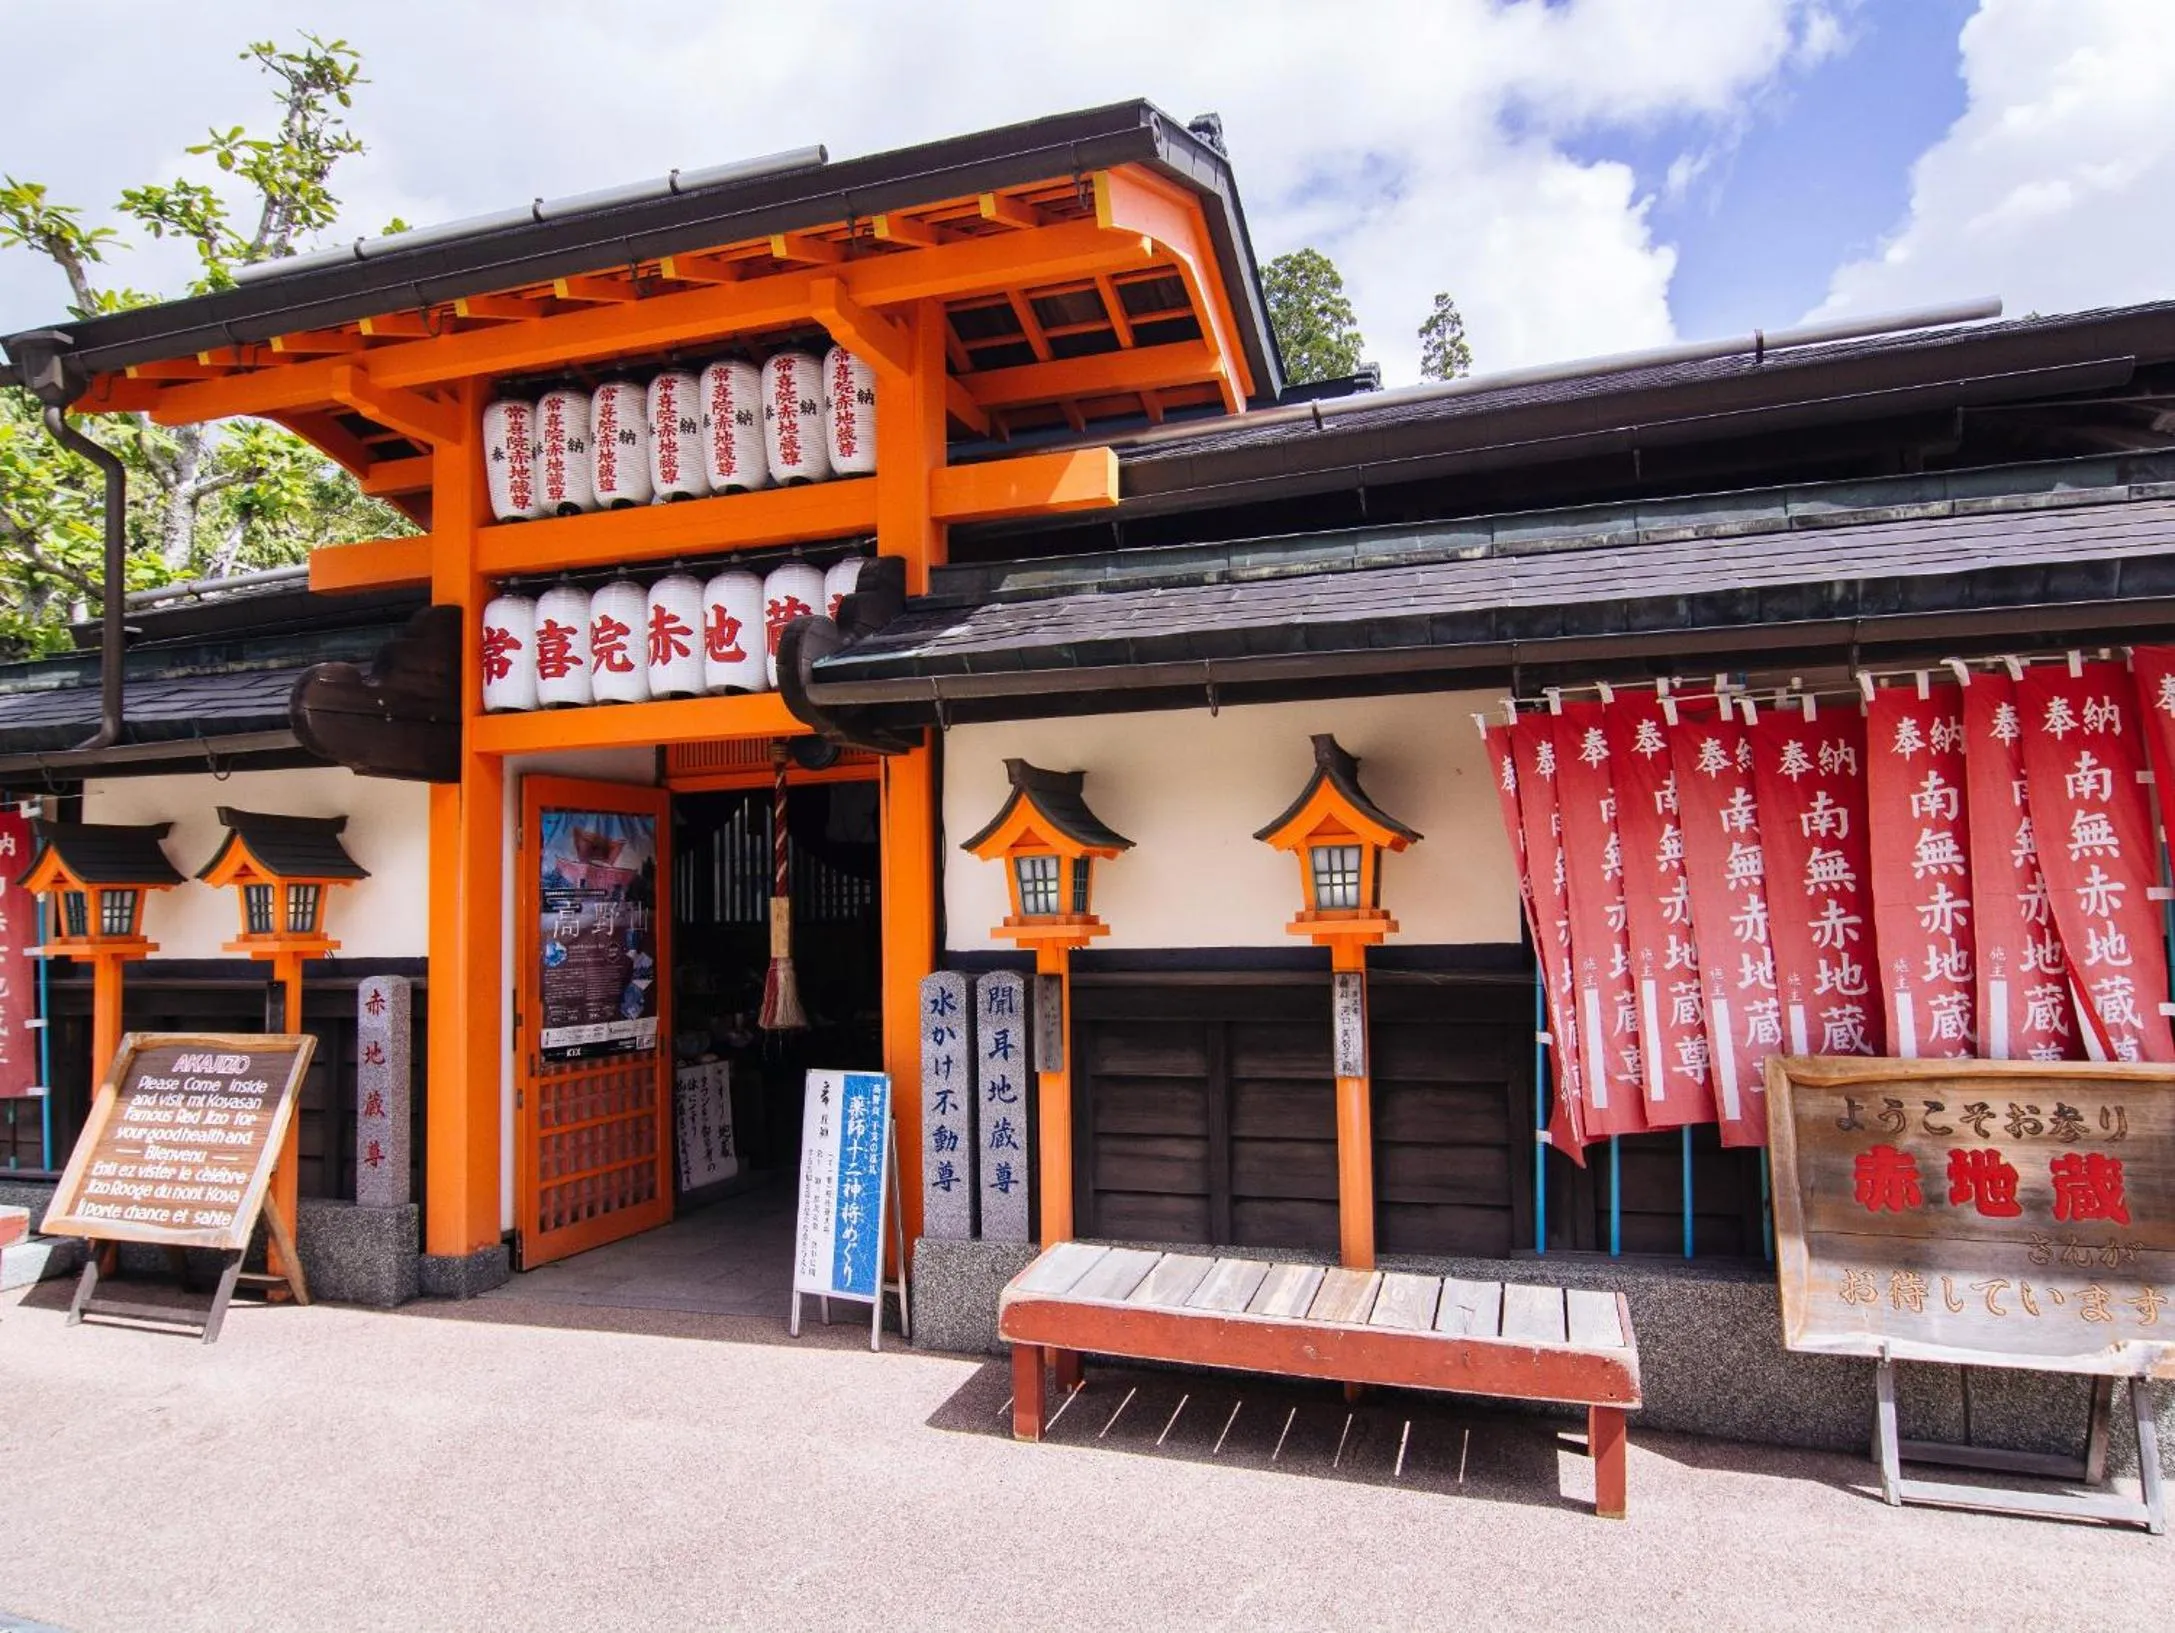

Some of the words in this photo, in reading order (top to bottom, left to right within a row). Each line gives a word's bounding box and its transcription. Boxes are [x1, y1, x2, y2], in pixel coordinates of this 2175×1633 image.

[1631, 718, 1668, 761] 奉
[1891, 715, 1966, 761] 奉納
[1990, 701, 2020, 746] 奉
[2041, 696, 2122, 741] 奉納
[1578, 727, 1610, 769] 奉
[1777, 738, 1858, 782] 奉納
[553, 900, 649, 938] 高野山
[138, 1075, 179, 1092] Please
[183, 1077, 221, 1092] Come
[363, 988, 386, 1168] 赤地蔵尊
[930, 986, 960, 1193] 水かけ不動尊
[123, 1107, 173, 1122] Famous
[175, 1108, 200, 1124] Red
[235, 1110, 257, 1126] for
[131, 1093, 155, 1106] and
[159, 1094, 184, 1106] visit
[208, 1094, 262, 1110] Koyasan
[1835, 1096, 2128, 1143] ようこそお参り
[115, 1126, 147, 1141] your
[145, 1125, 182, 1144] good
[181, 1128, 224, 1144] health
[225, 1130, 252, 1145] and
[1852, 1143, 2132, 1227] 赤地蔵
[1840, 1269, 2169, 1327] お待しています
